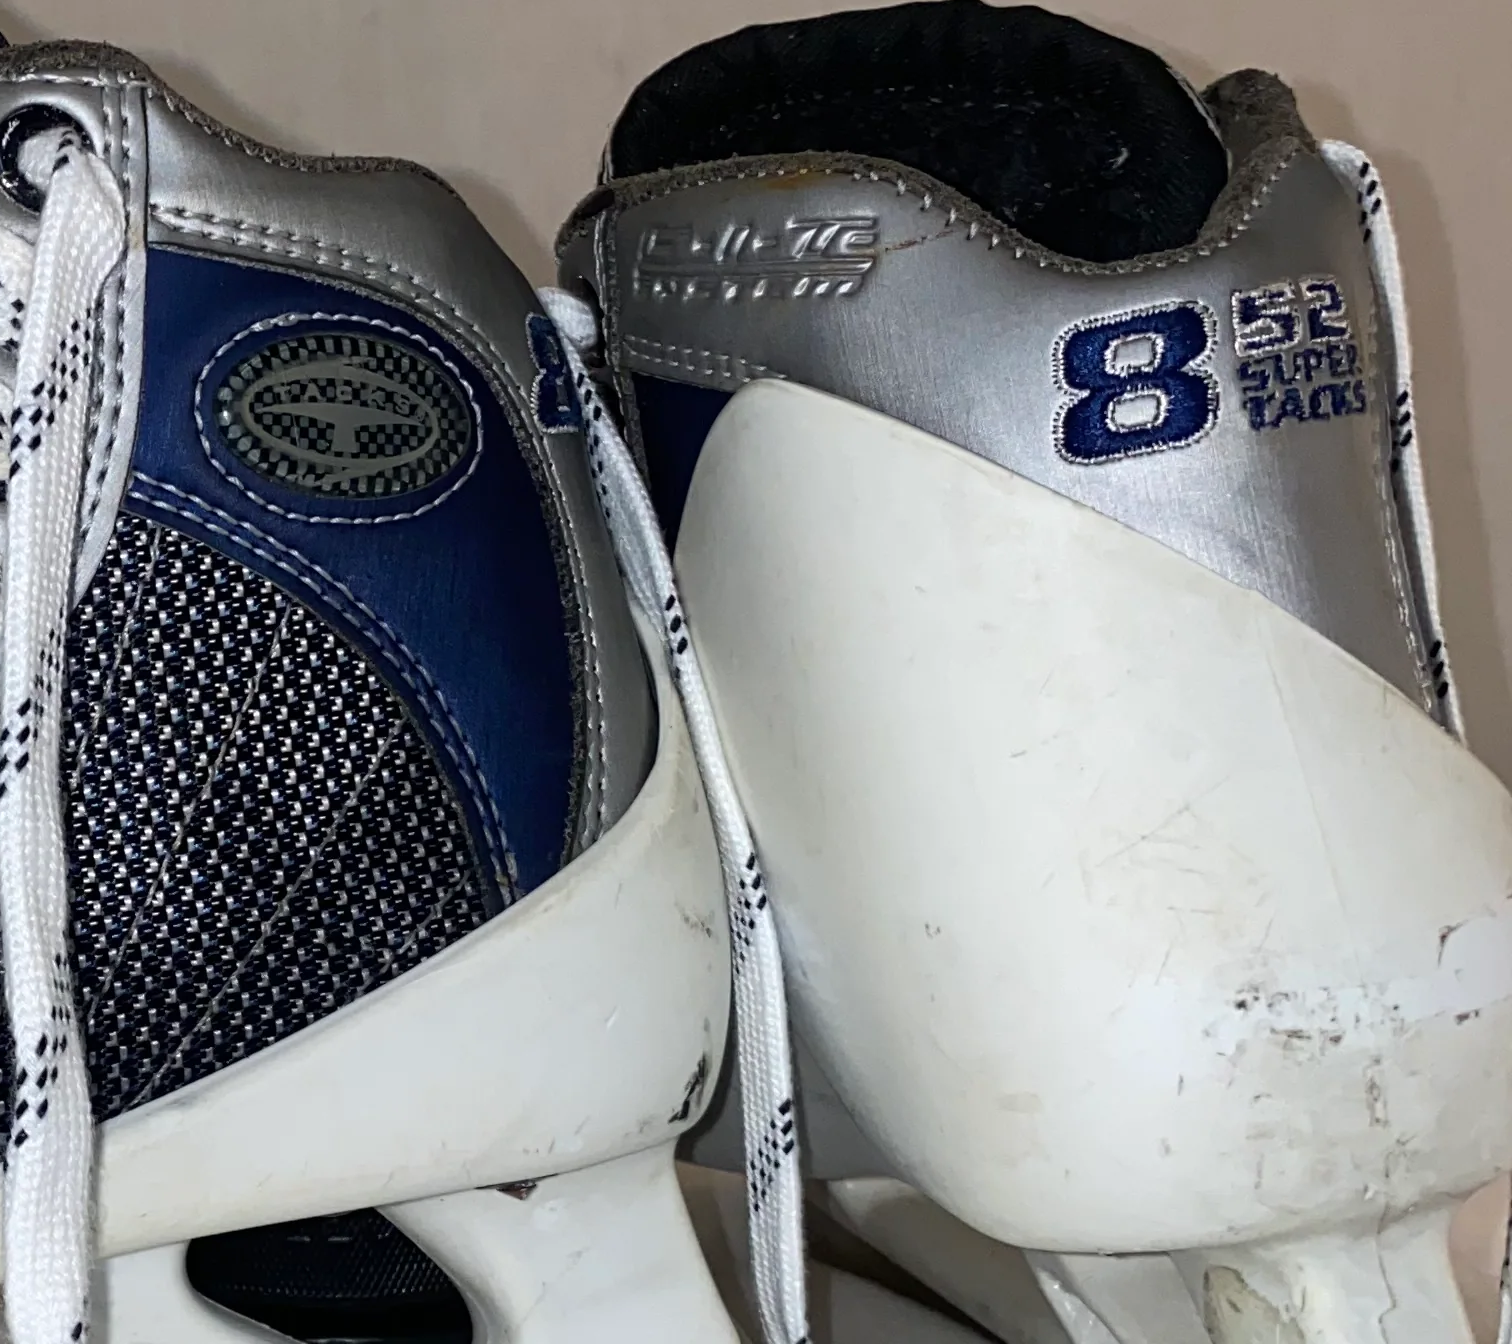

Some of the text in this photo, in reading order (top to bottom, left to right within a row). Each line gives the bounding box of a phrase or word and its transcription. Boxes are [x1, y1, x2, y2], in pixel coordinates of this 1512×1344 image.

[1231, 274, 1352, 357] 52
[1051, 299, 1220, 466] 8
[1238, 343, 1363, 392] SUPER
[272, 382, 413, 414] TACKS
[1242, 379, 1367, 431] TACKS
